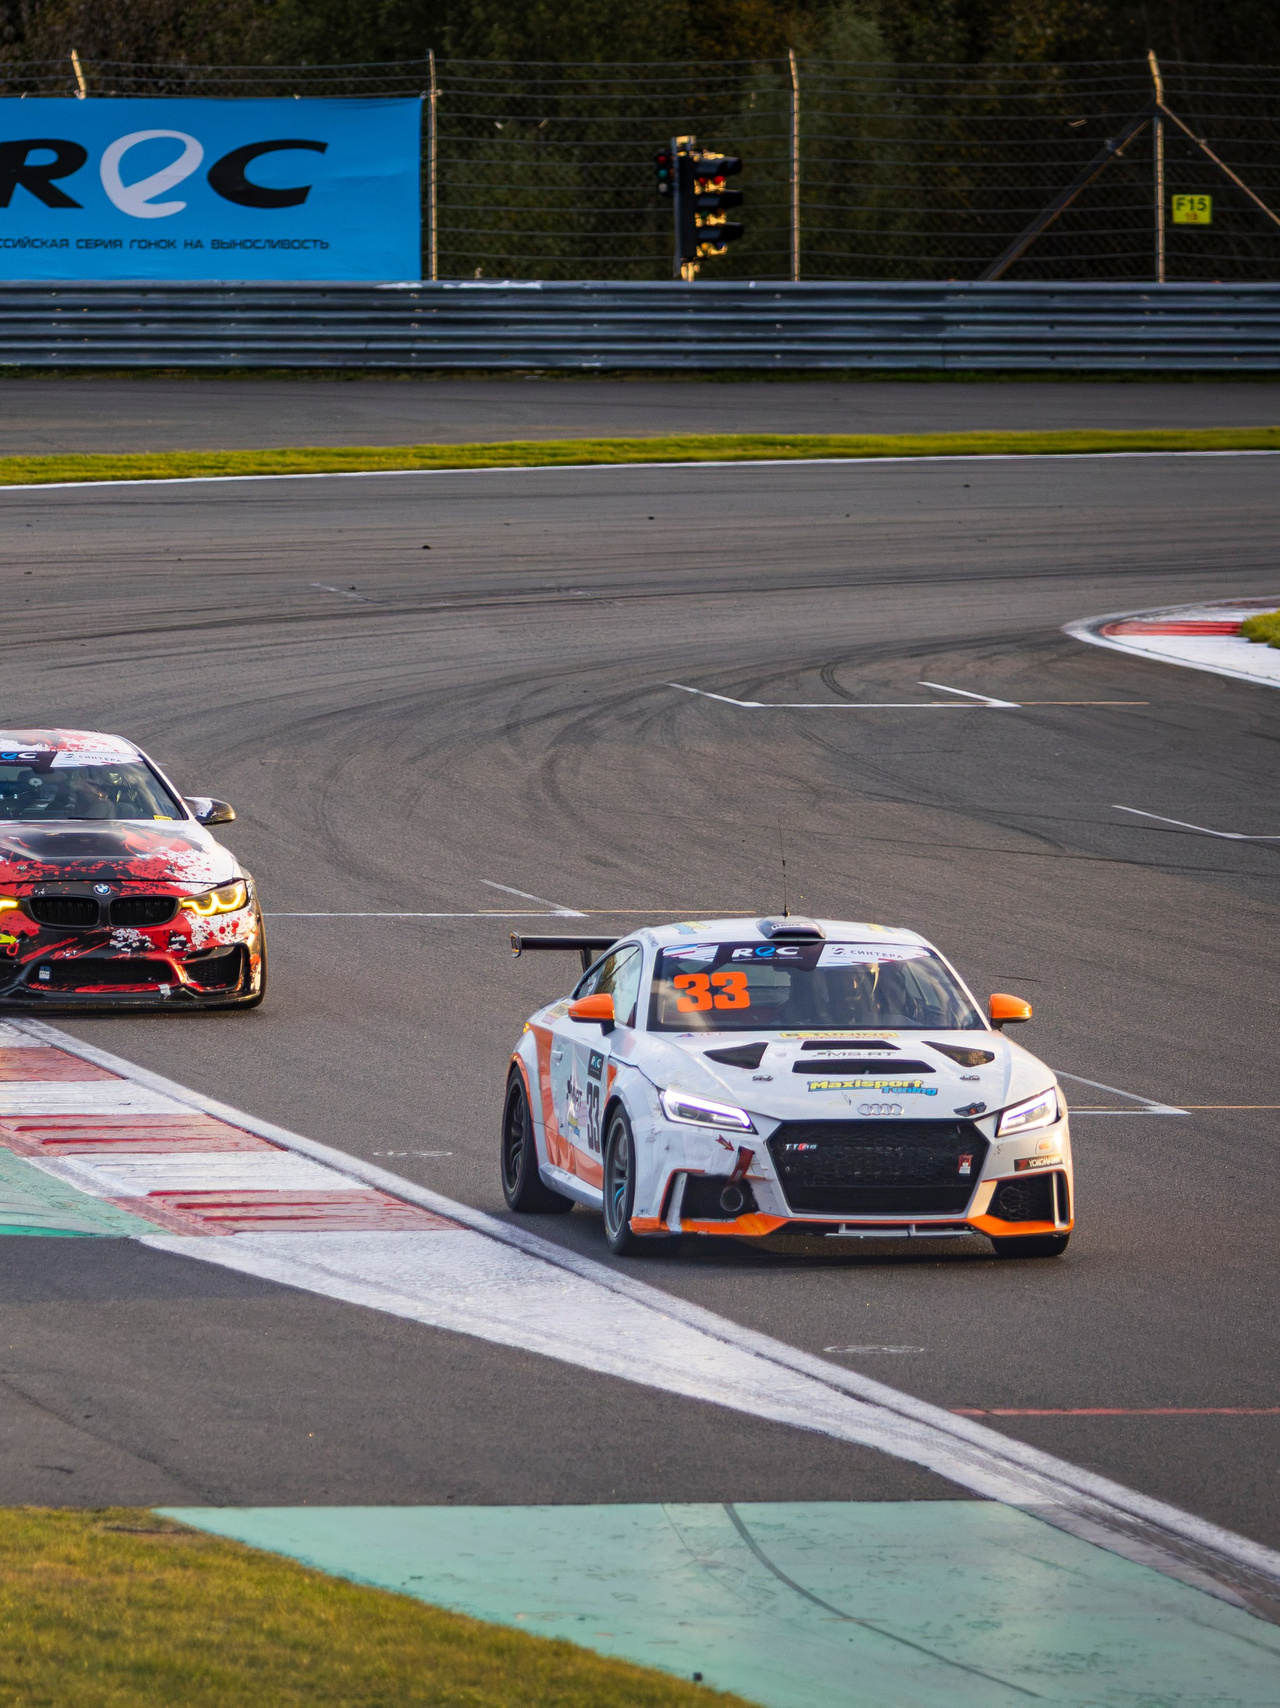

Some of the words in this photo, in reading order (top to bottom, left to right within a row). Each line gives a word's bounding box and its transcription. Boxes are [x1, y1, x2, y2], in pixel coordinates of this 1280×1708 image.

[1175, 197, 1207, 212] F15
[76, 239, 123, 249] СЕРИЯ
[129, 239, 176, 249] ГОНОК
[184, 239, 204, 249] НА
[211, 239, 329, 249] ВЫНОСЛИВОСТЬ
[78, 755, 122, 763] СИНТЕРА
[850, 949, 904, 959] СИНТЕРА
[673, 971, 751, 1013] 33
[586, 1081, 600, 1153] 33
